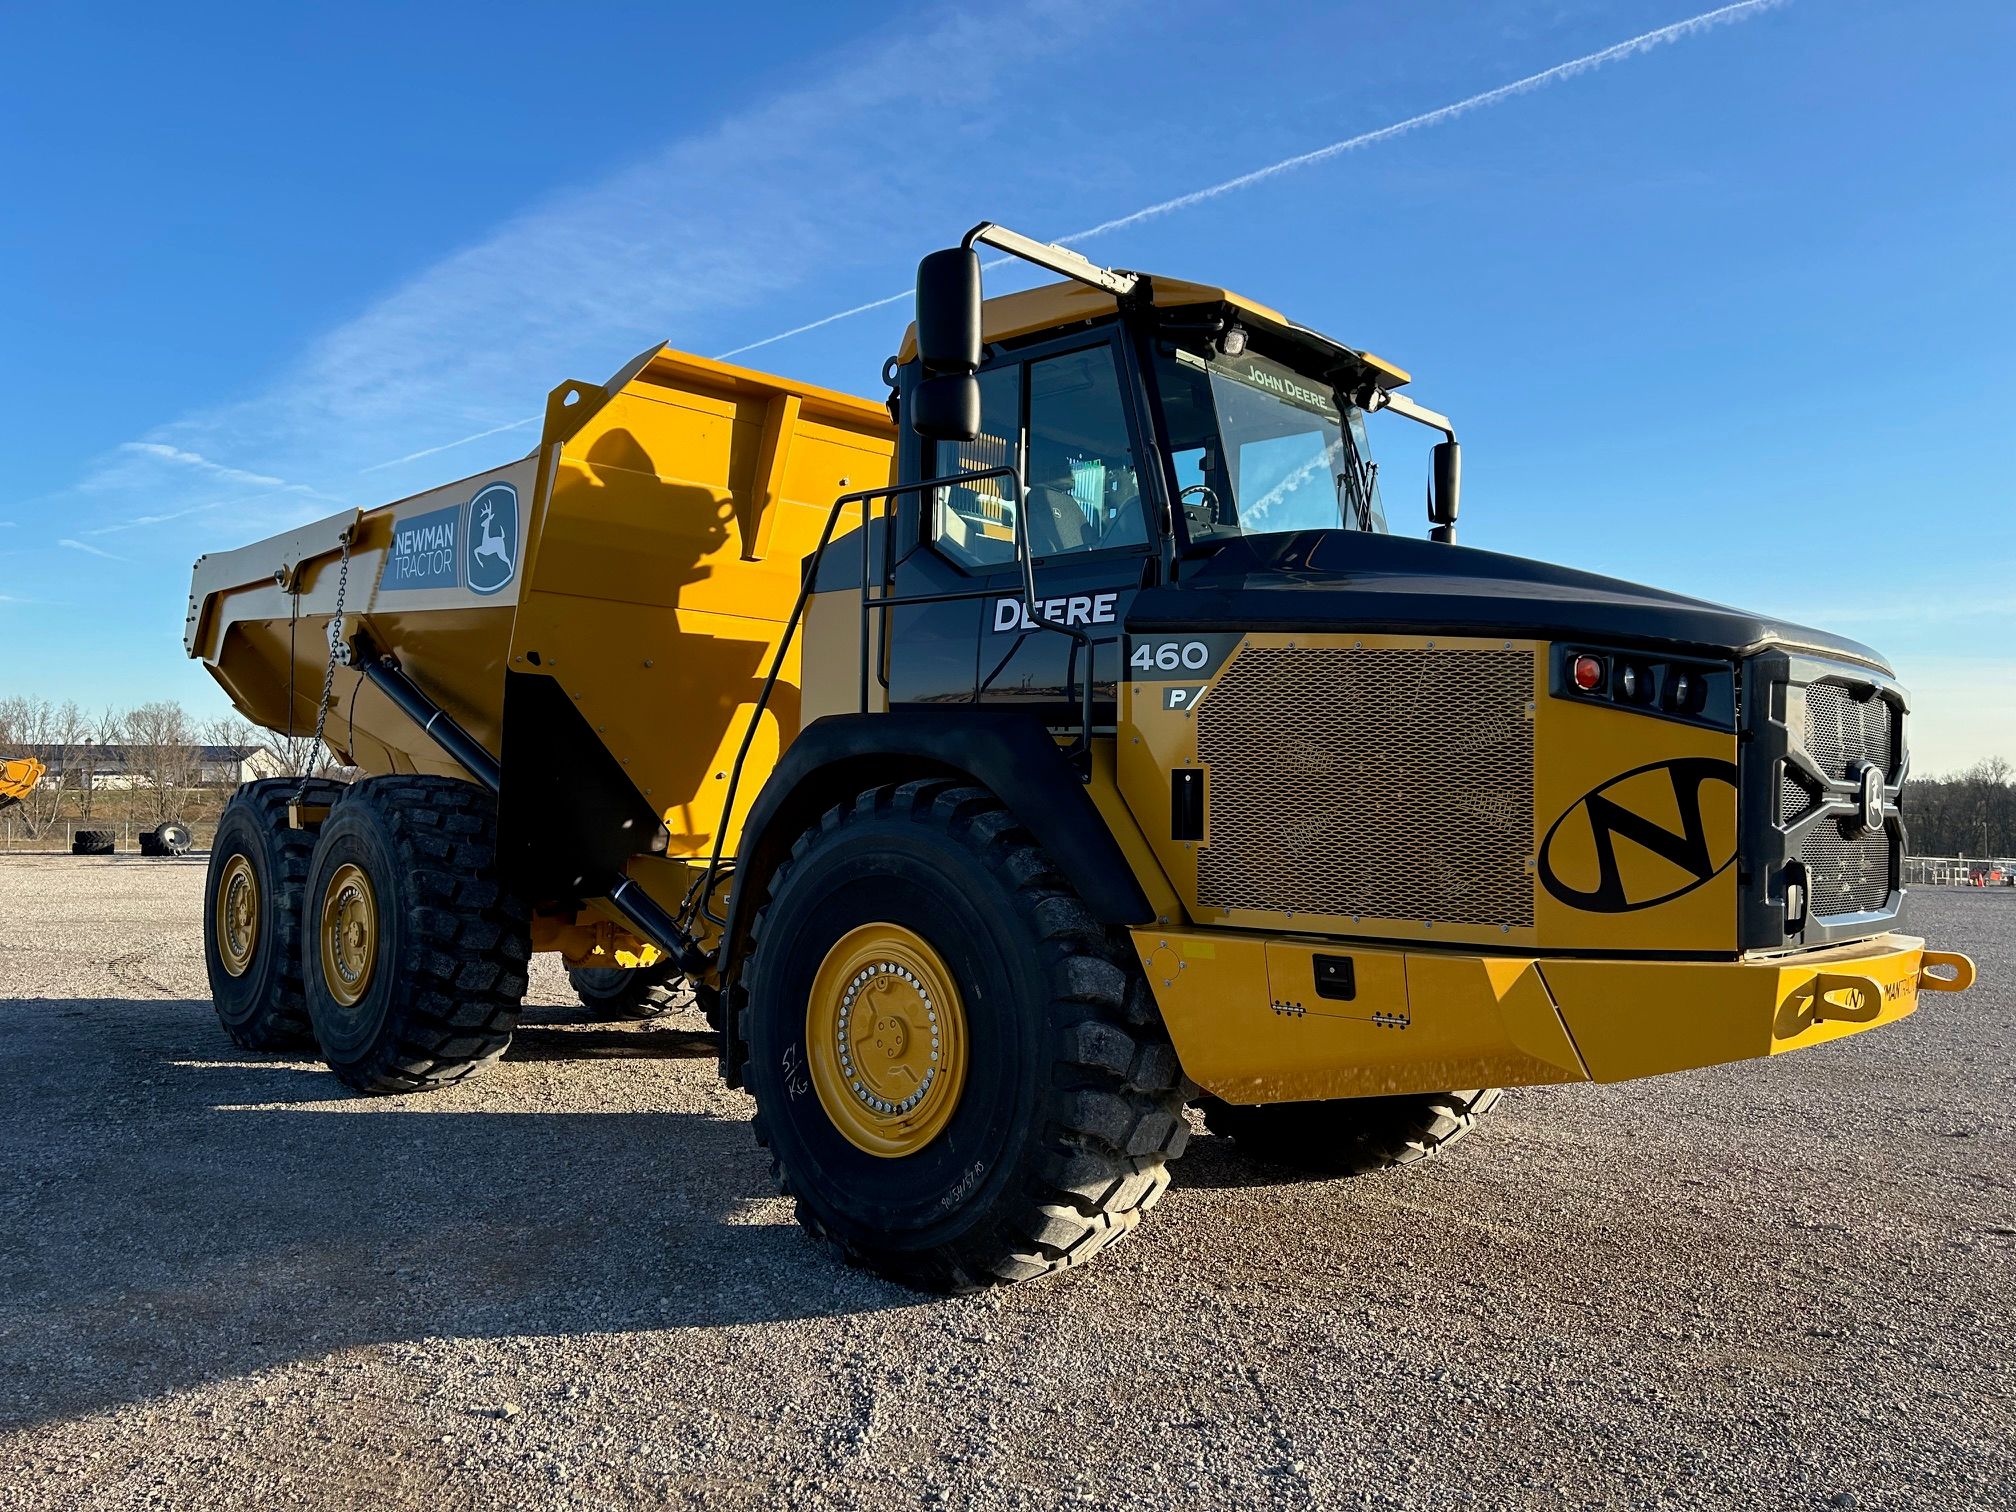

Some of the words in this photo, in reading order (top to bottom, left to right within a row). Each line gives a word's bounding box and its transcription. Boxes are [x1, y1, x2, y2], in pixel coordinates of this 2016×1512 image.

[1248, 365, 1283, 392] JOHN
[1285, 379, 1328, 410] DEERE
[395, 522, 454, 556] NEWMAN
[395, 549, 452, 580] TRACTOR
[994, 593, 1117, 631] DEERE
[1130, 641, 1209, 671] 460
